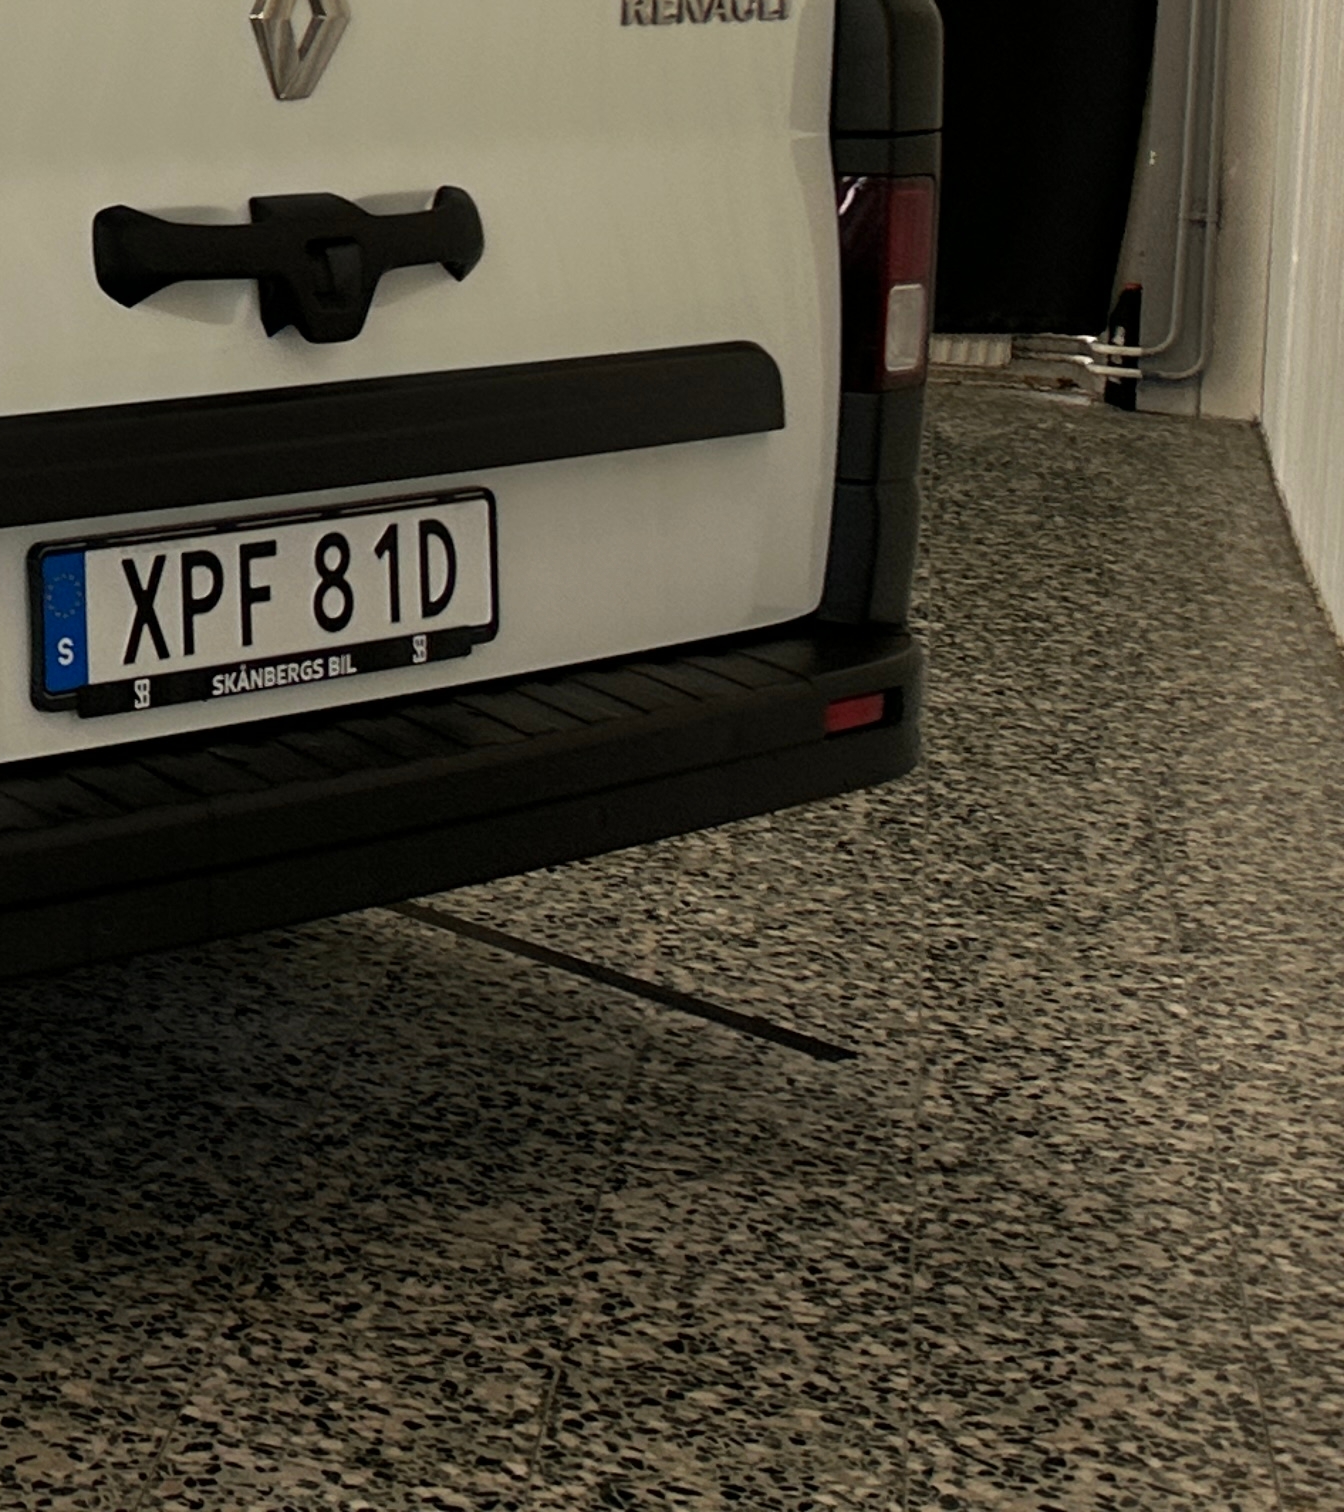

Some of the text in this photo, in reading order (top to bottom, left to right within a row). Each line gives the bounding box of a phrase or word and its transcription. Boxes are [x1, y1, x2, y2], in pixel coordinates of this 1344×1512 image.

[120, 518, 458, 666] XPF 81D
[56, 637, 75, 667] S
[212, 653, 358, 696] SKÅNBERGS BIL
